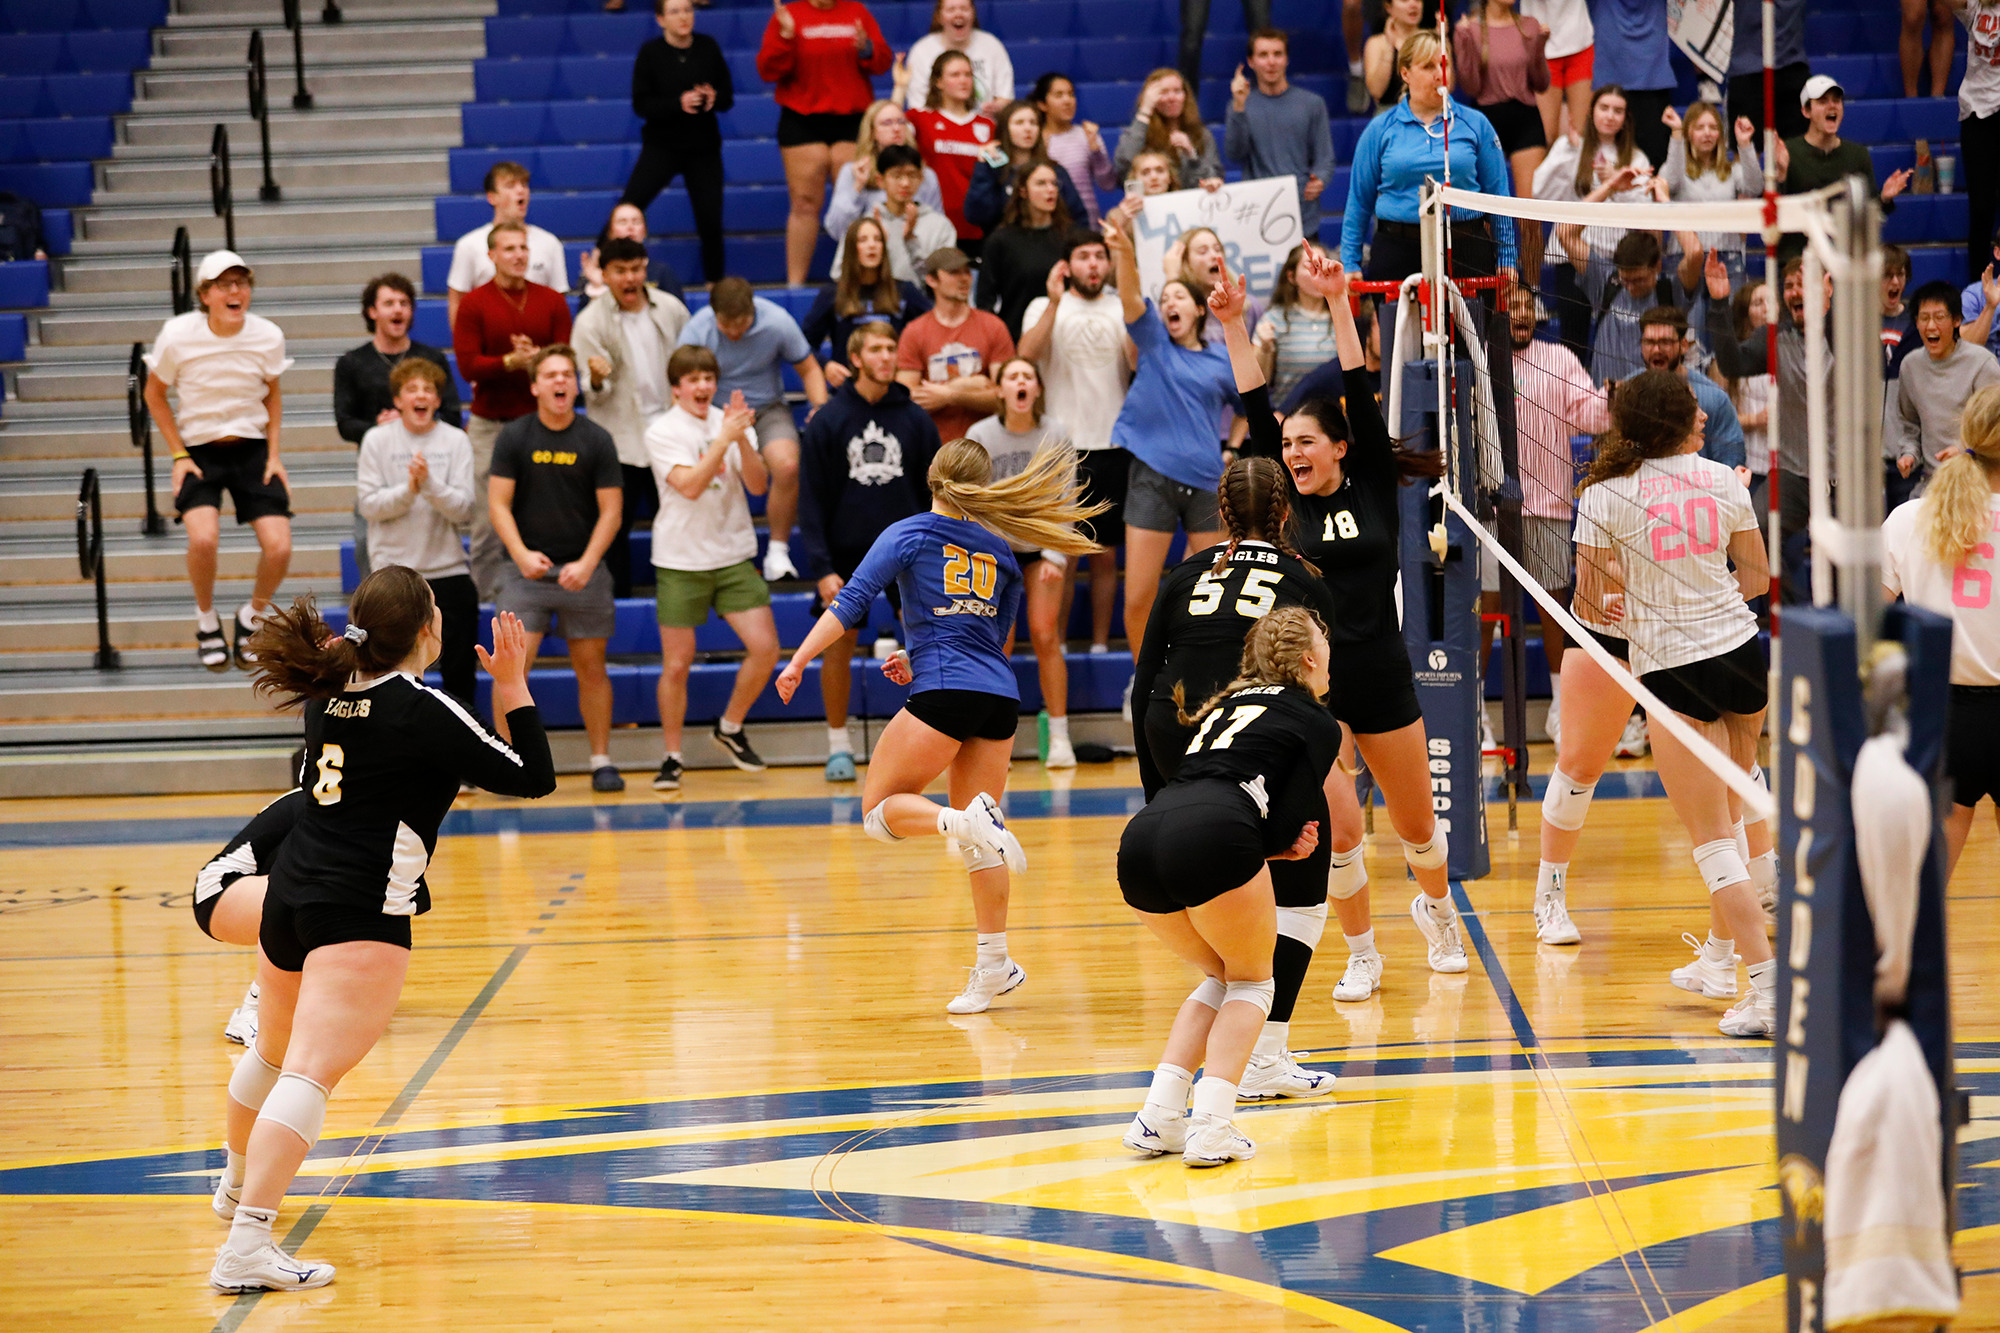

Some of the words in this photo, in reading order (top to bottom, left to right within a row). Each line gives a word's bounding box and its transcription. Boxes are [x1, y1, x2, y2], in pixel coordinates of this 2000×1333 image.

[532, 450, 553, 464] GO
[1639, 470, 1713, 499] STEWARD
[1322, 510, 1359, 542] 18
[1646, 496, 1719, 562] 20
[942, 543, 998, 601] 20
[1211, 551, 1279, 565] EAGLES
[1951, 542, 1995, 609] 6
[1188, 567, 1285, 620] 55
[324, 697, 372, 719] EAGLES
[1184, 704, 1268, 756] 17
[312, 743, 345, 806] 6
